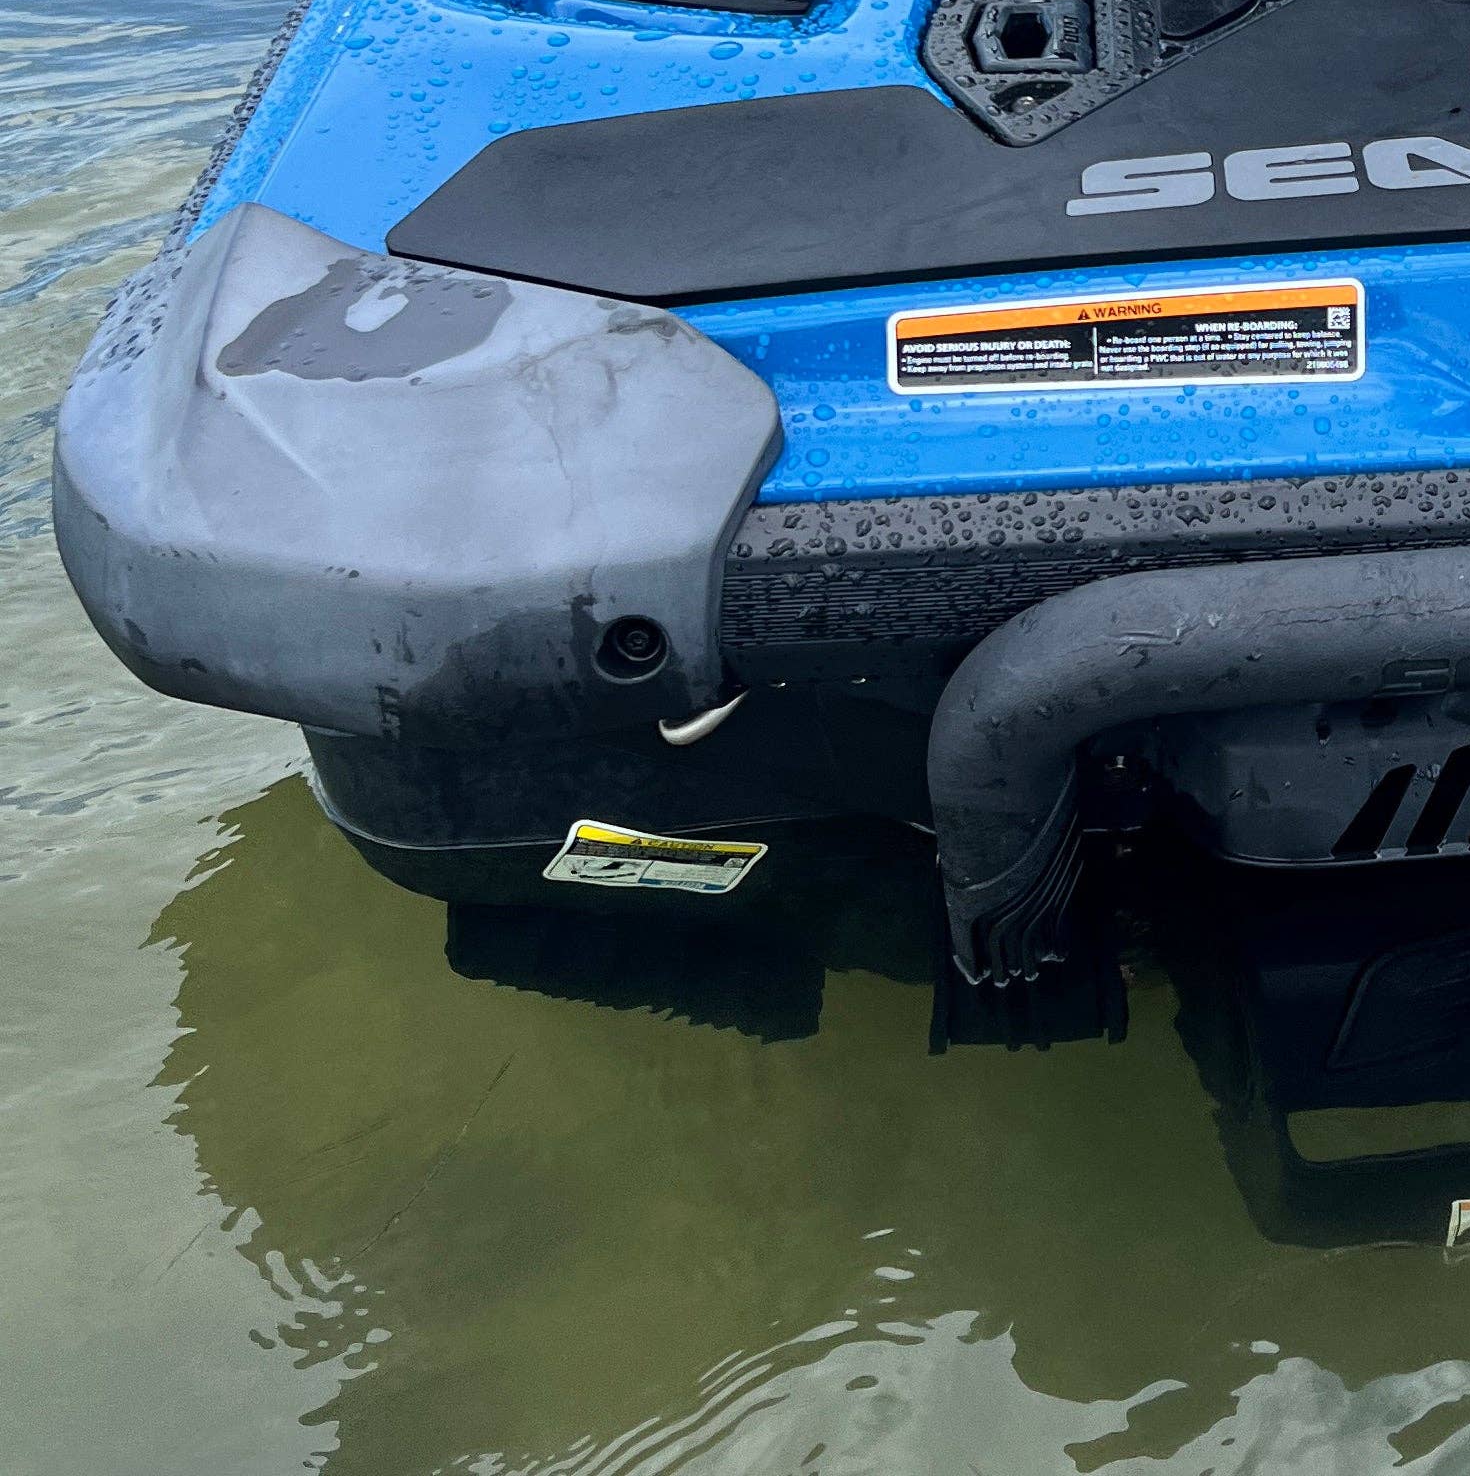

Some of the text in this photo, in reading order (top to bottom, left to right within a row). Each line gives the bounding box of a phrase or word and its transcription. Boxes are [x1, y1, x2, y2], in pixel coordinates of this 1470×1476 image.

[1093, 303, 1162, 318] WARNING
[1195, 323, 1226, 332] WHEN
[902, 343, 936, 354] AVOID
[936, 342, 980, 353] SERIOUS
[980, 341, 1016, 352] INJURY
[1017, 340, 1033, 351] OR
[1150, 354, 1169, 363] PWC
